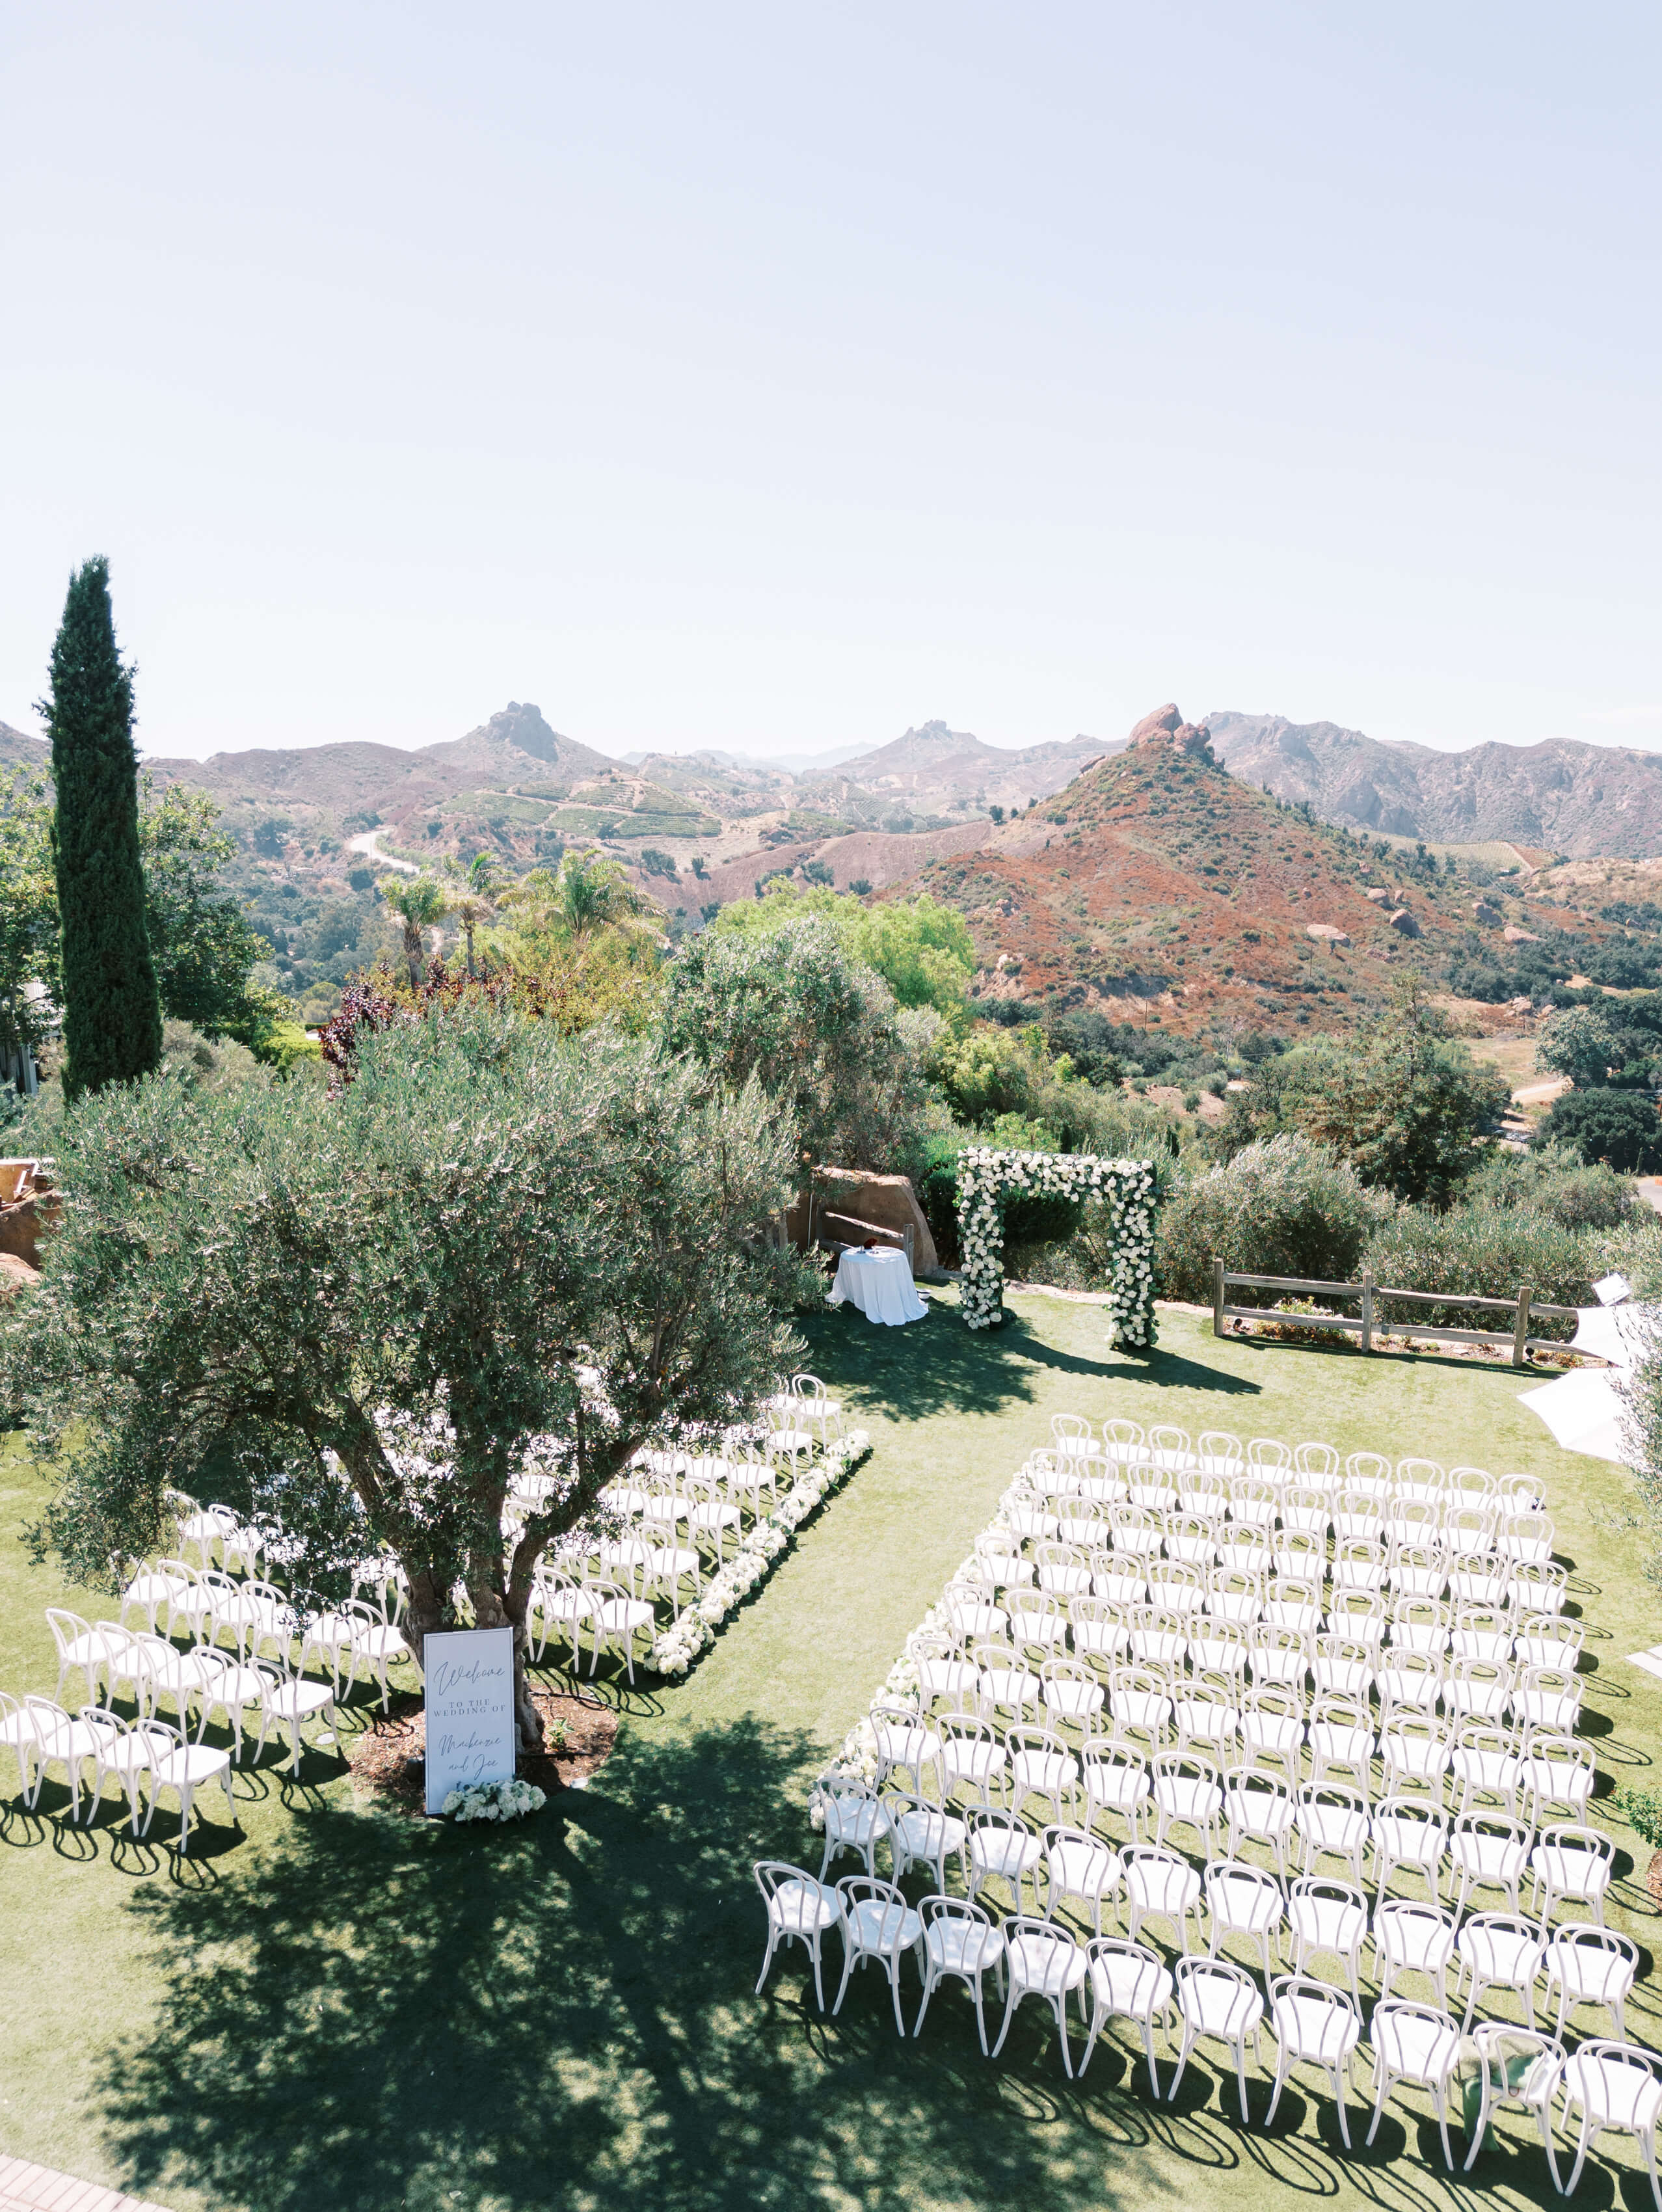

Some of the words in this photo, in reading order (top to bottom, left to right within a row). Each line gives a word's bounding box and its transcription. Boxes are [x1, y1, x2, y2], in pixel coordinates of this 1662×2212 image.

[433, 1660, 505, 1696] Welcome
[433, 1706, 487, 1718] WEDDING
[492, 1705, 506, 1713] OF
[468, 1699, 490, 1707] THE
[438, 1732, 502, 1757] Mackenzie
[448, 1757, 468, 1773] and
[472, 1753, 499, 1780] Joe
